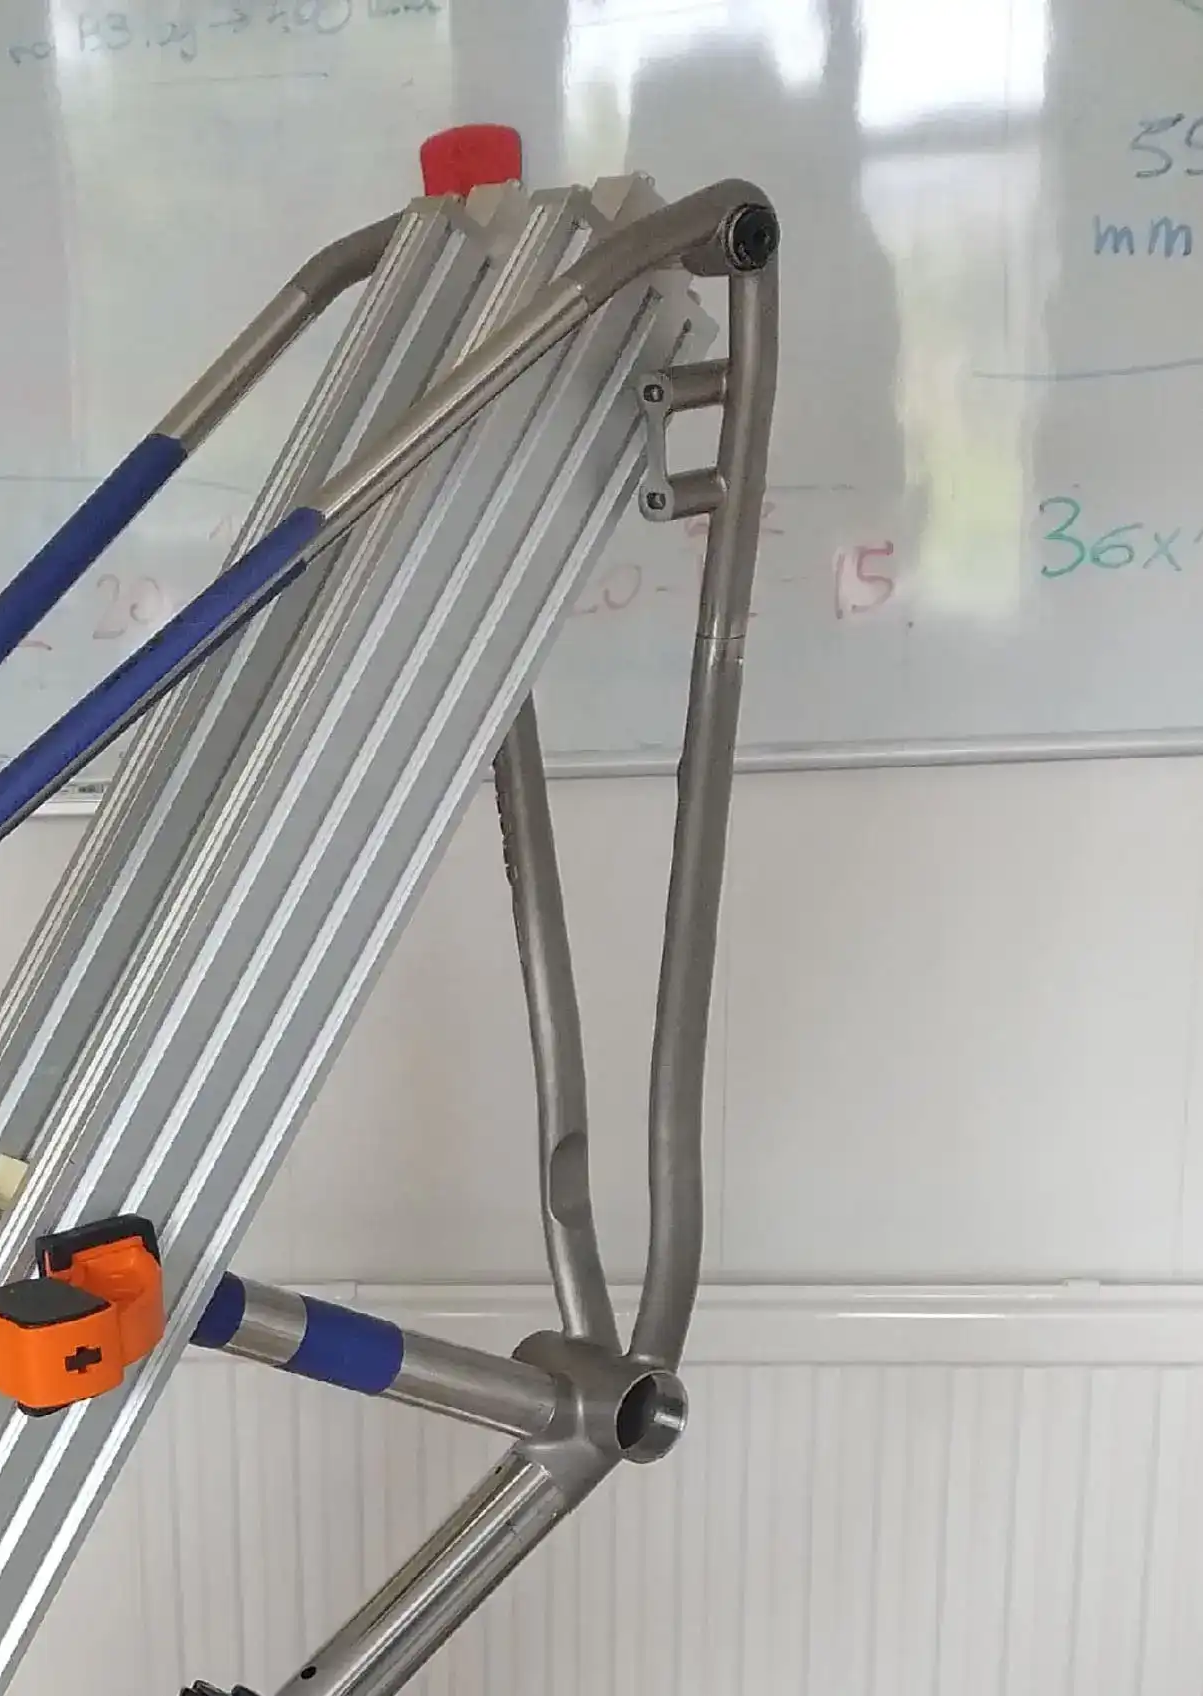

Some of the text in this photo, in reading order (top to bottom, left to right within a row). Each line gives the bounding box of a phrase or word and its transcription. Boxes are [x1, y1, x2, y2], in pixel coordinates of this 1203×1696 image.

[1092, 214, 1194, 258] mm
[93, 573, 161, 641] 20
[834, 539, 894, 620] 15
